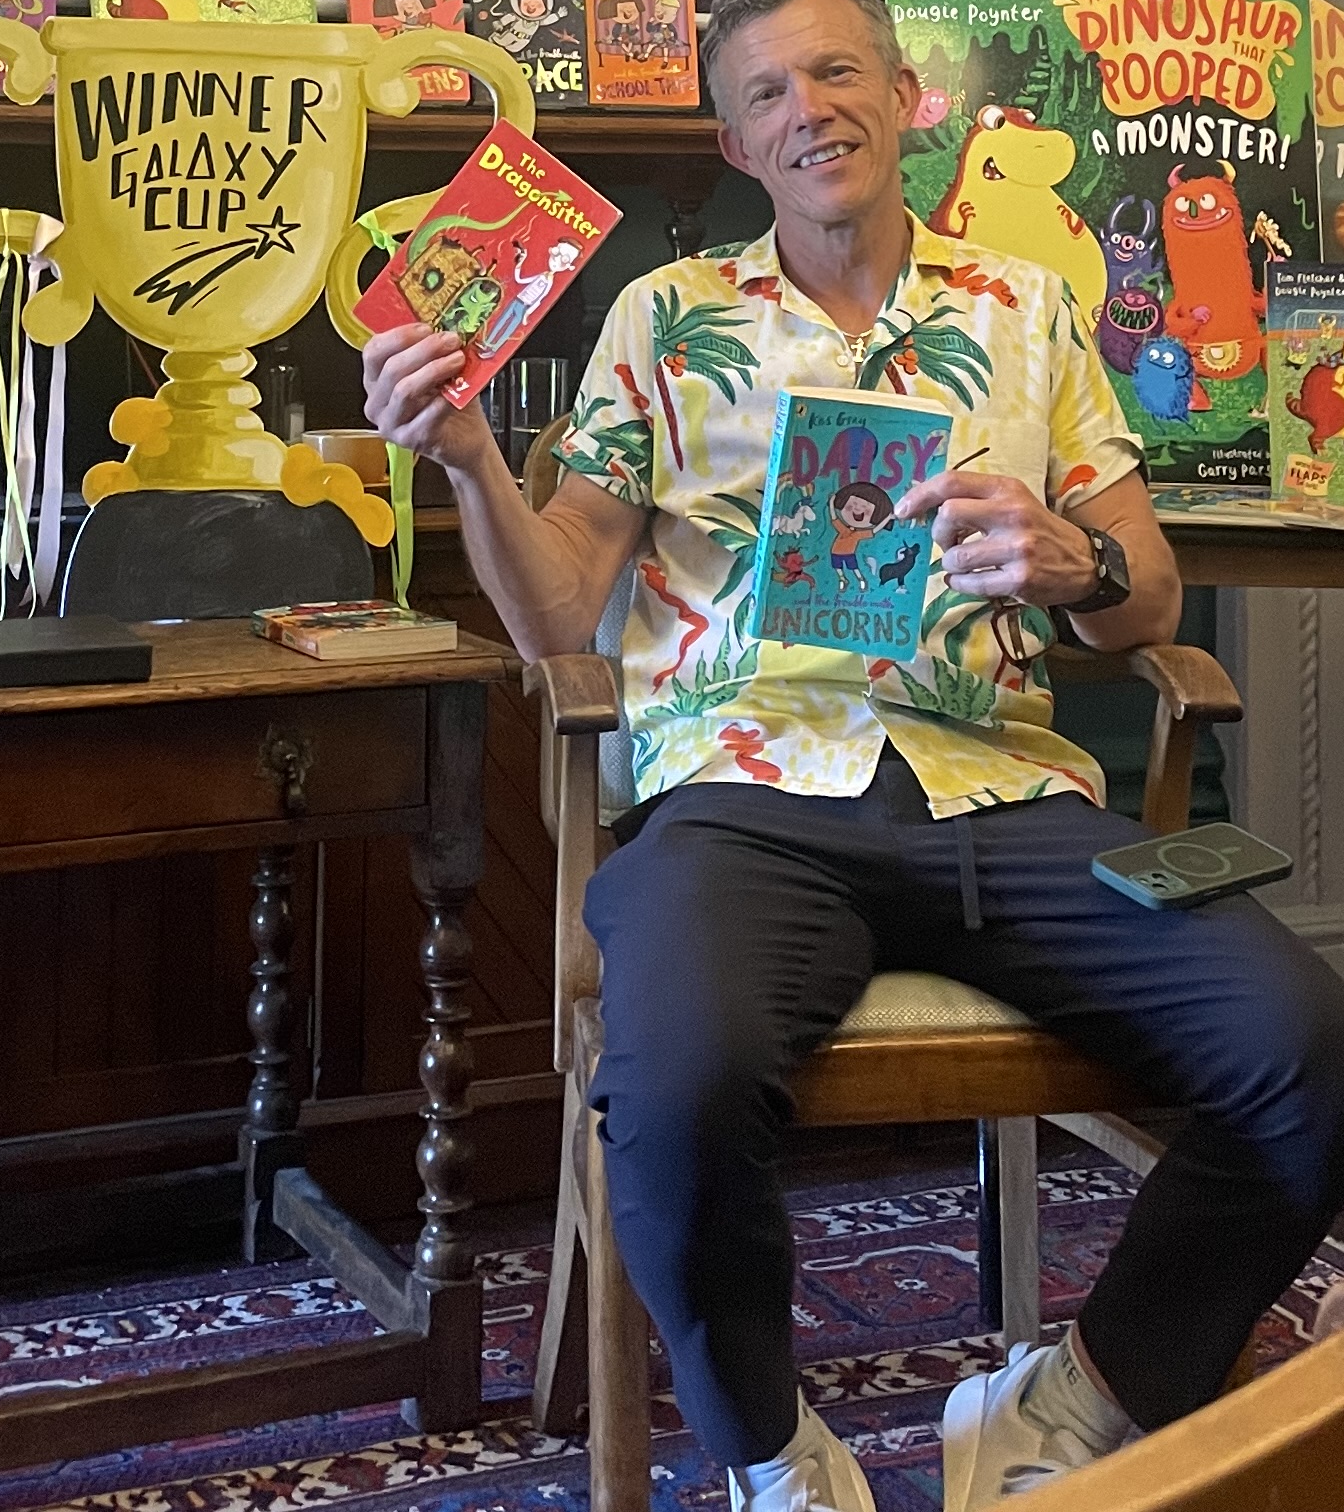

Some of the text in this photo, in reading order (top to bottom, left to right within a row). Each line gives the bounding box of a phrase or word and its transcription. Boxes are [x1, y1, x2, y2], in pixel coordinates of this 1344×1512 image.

[894, 3, 1044, 26] Dougie Poynter
[1231, 39, 1267, 63] THAT
[520, 58, 583, 94] PACE
[1097, 49, 1265, 110] POOPED
[70, 69, 327, 162] WINNER
[1091, 111, 1292, 170] A MONSTER!
[111, 143, 298, 214] GALAXY
[519, 152, 546, 180] The
[478, 143, 602, 240] Dragonsitter
[142, 187, 248, 233] CUP
[1274, 286, 1307, 297] Dougie
[1276, 272, 1294, 284] Tom
[1297, 272, 1336, 284] Fletcher
[808, 410, 867, 429] Kes Gray
[791, 432, 945, 489] DAISY
[1212, 448, 1262, 461] Illustrated
[1197, 462, 1238, 481] Garry
[1289, 467, 1329, 486] FLAPS
[762, 606, 912, 647] UNICORNS
